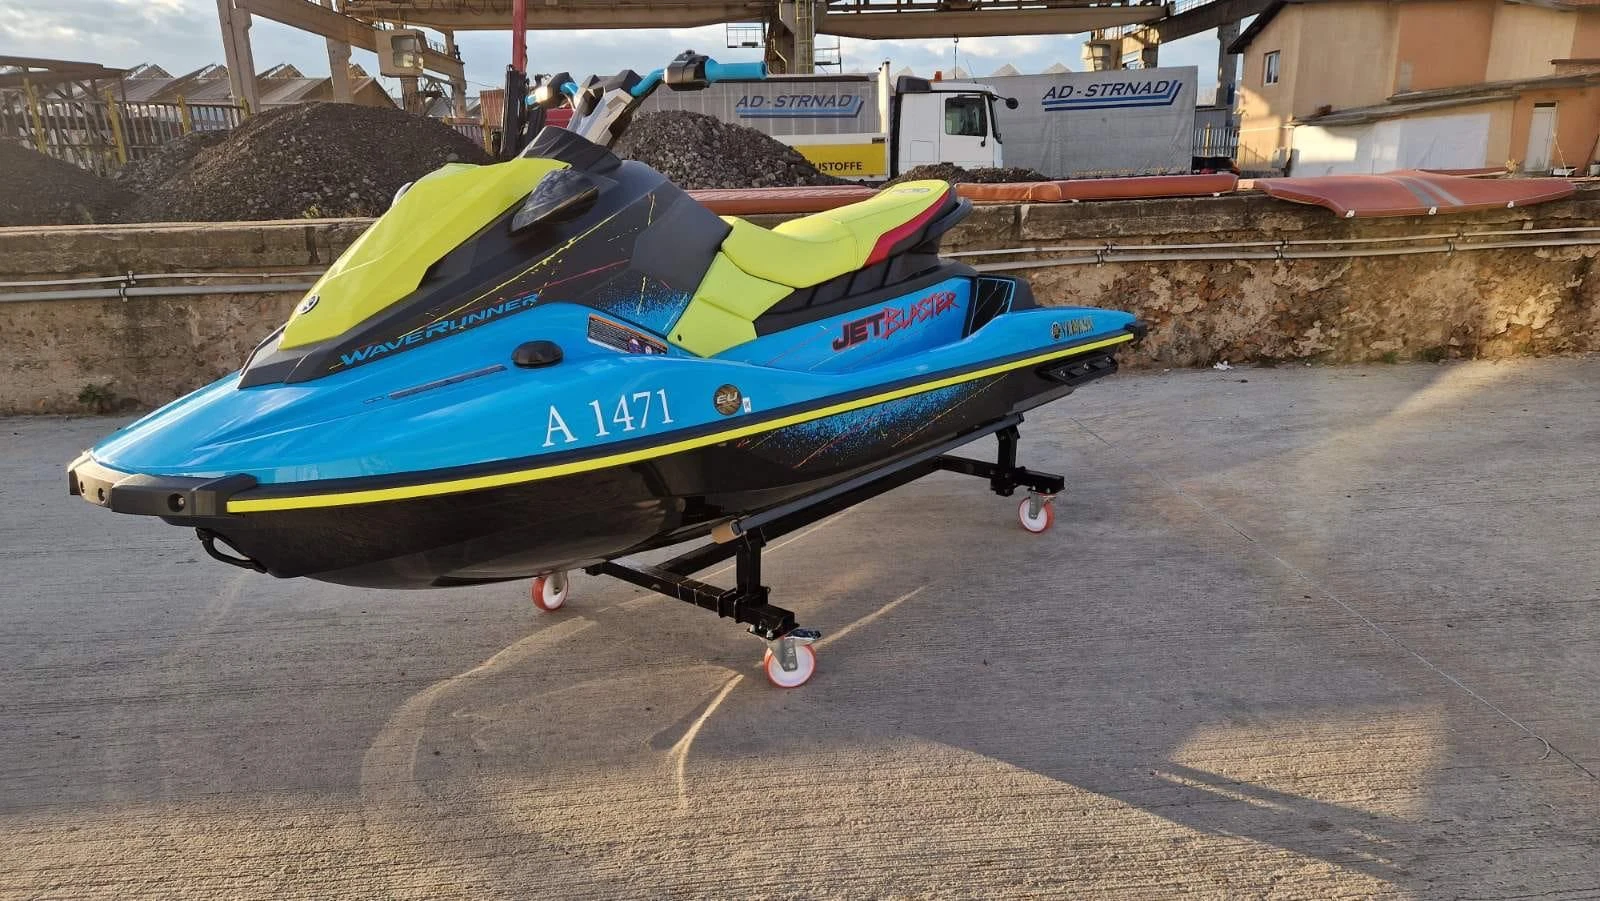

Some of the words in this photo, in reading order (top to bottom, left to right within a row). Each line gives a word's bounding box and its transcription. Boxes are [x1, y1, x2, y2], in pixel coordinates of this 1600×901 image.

[1042, 85, 1074, 99] AD
[1085, 80, 1170, 97] STRNAD
[736, 95, 764, 107] AD
[774, 94, 852, 107] STRNAD
[542, 404, 578, 447] A
[588, 388, 674, 437] 1471
